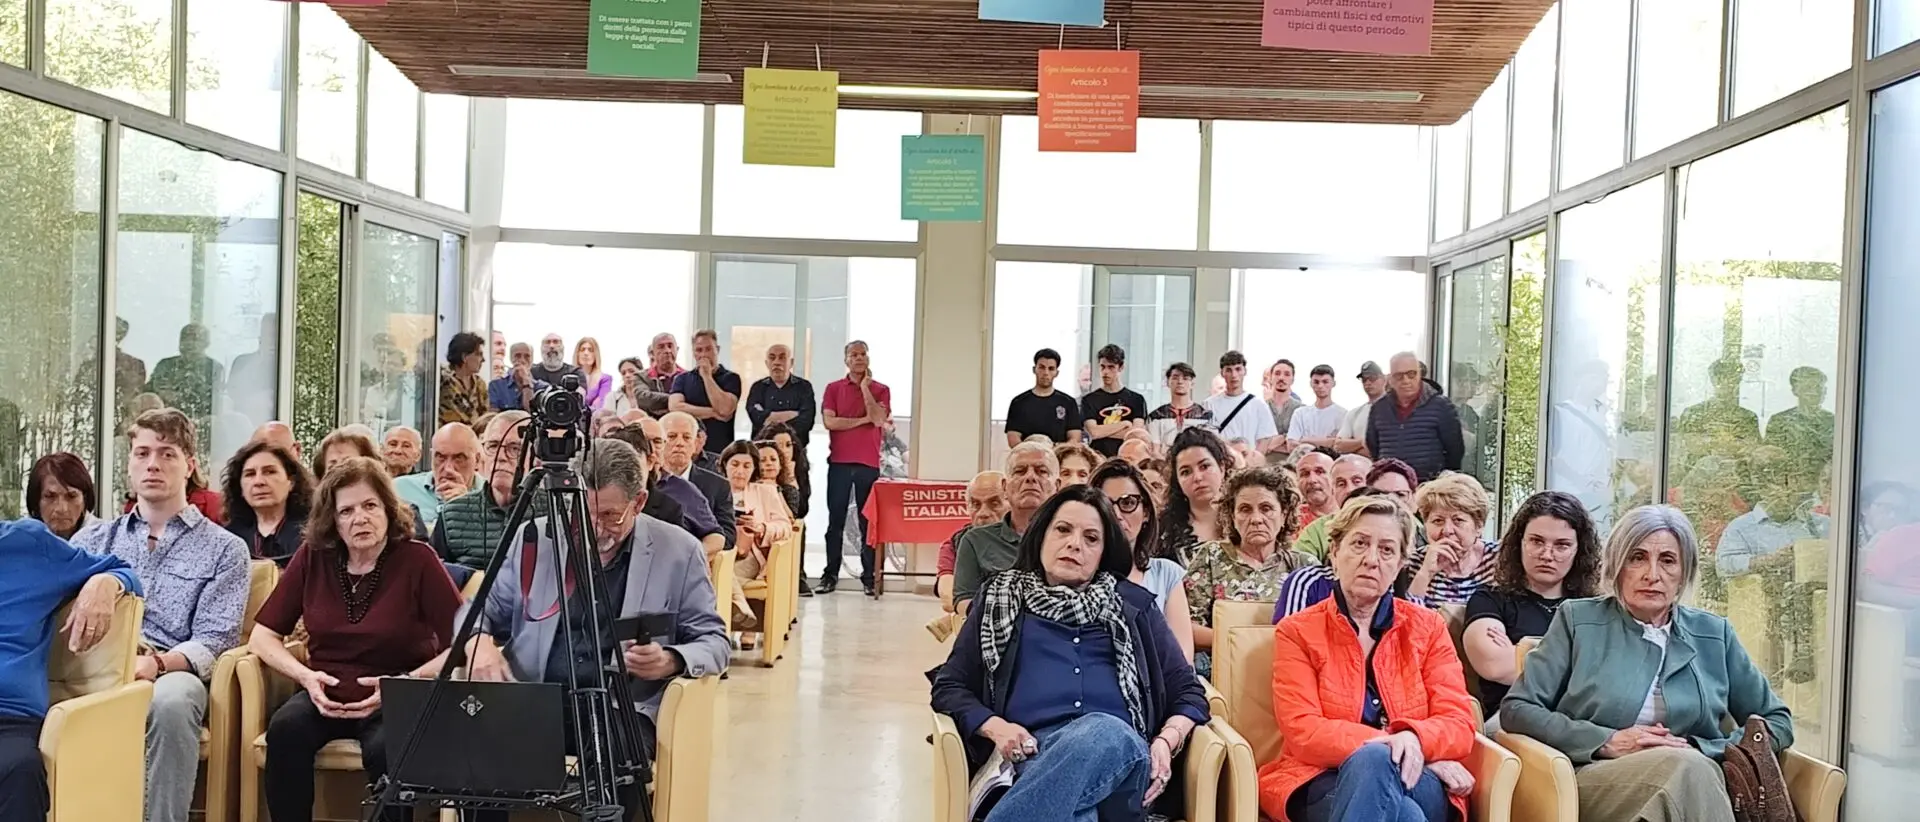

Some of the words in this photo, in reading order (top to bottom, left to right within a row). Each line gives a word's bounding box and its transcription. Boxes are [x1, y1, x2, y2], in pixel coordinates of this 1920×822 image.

[1273, 7, 1340, 19] cambiamenti
[1343, 12, 1367, 20] fisici
[1370, 12, 1382, 21] ed
[1386, 14, 1424, 24] emotivi
[1288, 20, 1314, 31] tipici
[1317, 22, 1326, 31] di
[1329, 24, 1363, 34] questo
[1071, 78, 1101, 86] Articolo
[903, 489, 968, 501] SINISTR
[904, 505, 971, 516] ITALIAN
